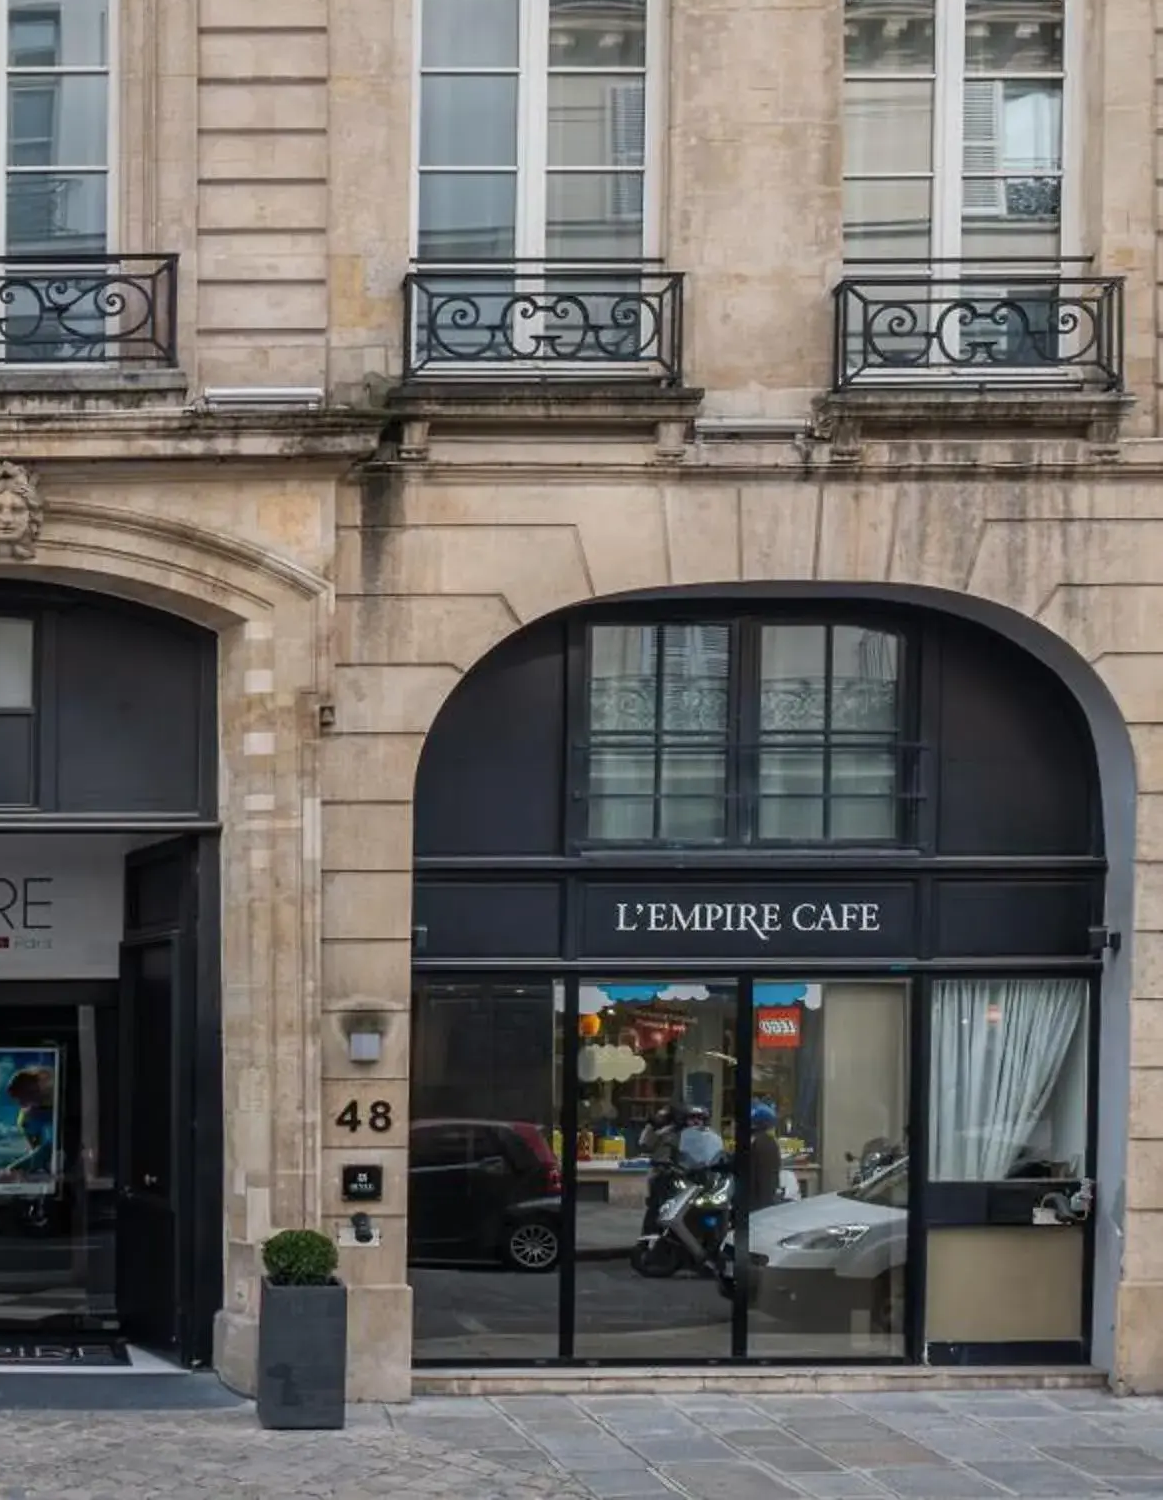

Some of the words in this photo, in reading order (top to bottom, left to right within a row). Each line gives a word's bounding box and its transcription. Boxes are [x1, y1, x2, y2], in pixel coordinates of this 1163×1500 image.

[615, 903, 782, 941] L'EMPIRE
[791, 903, 880, 931] CAFE
[335, 1099, 392, 1133] 48
